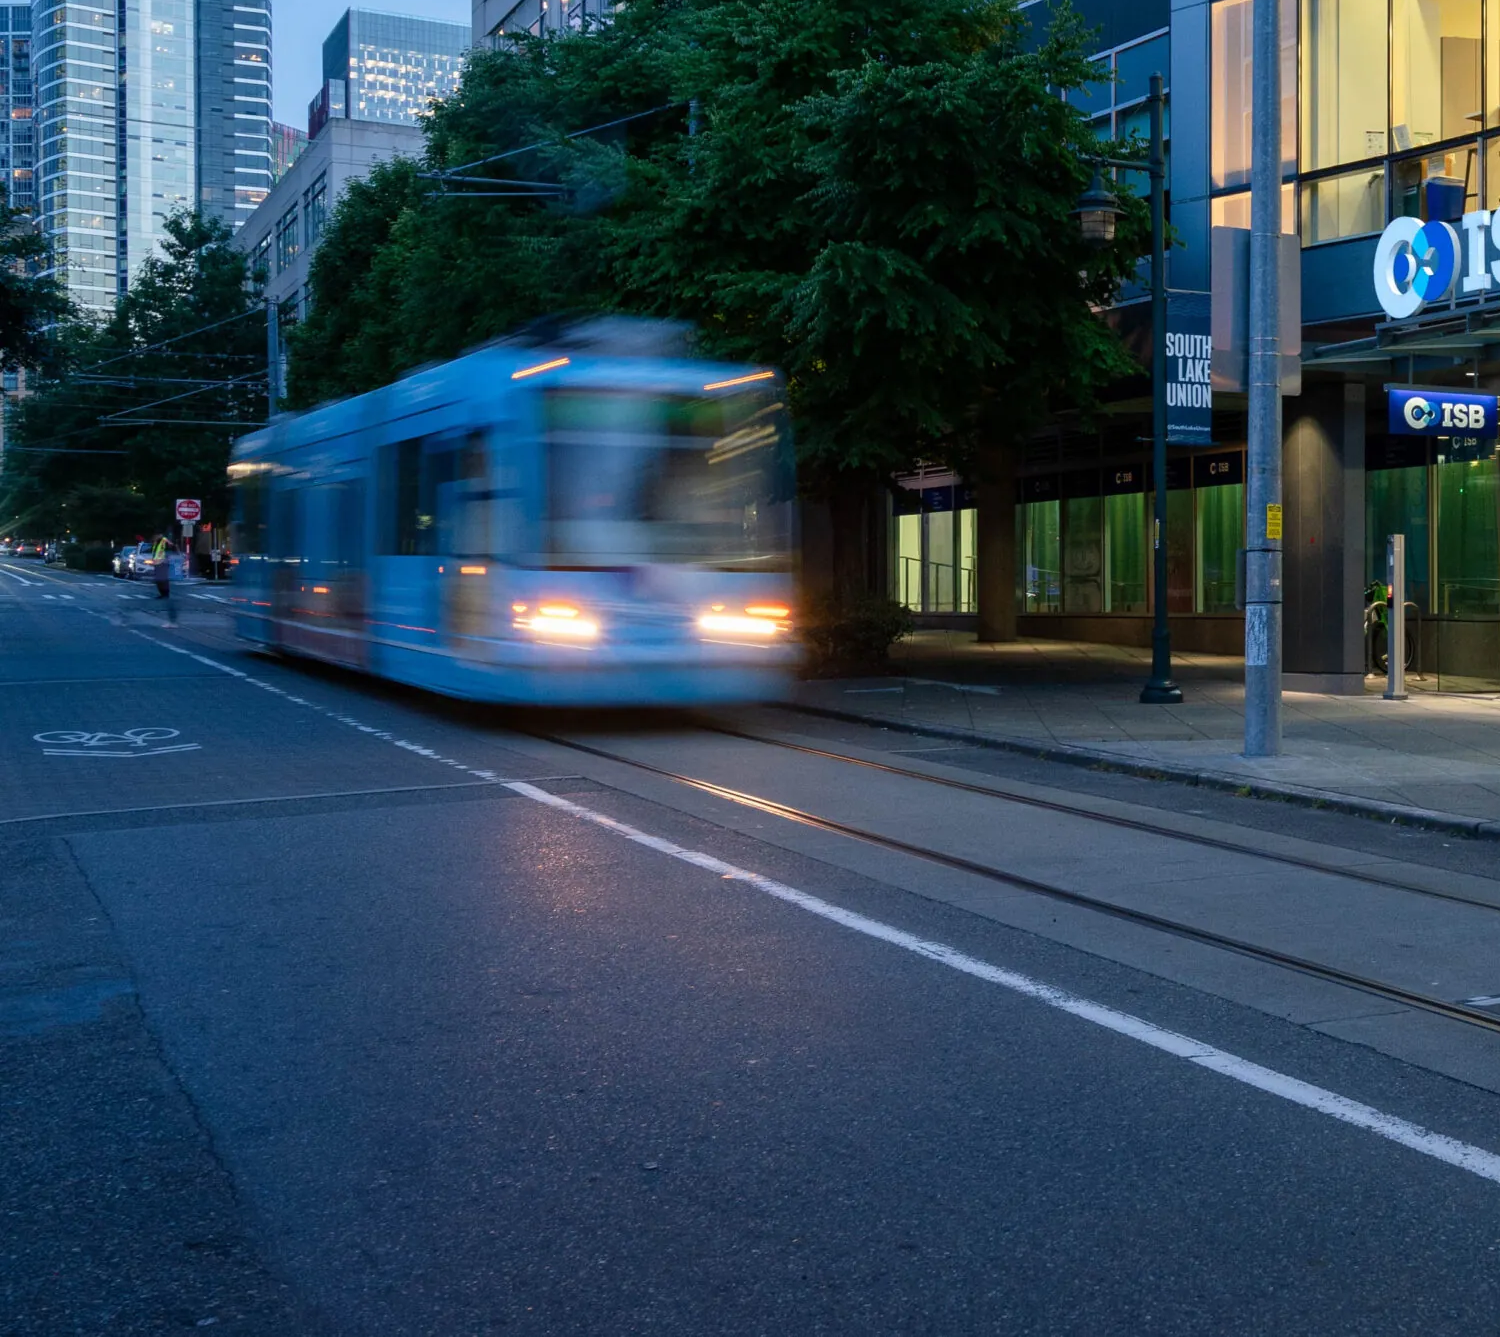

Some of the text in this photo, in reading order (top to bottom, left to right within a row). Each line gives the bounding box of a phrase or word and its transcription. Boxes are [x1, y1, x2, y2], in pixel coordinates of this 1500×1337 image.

[1166, 332, 1212, 359] SOUTH
[1178, 358, 1212, 383] LAKE
[1166, 382, 1212, 408] UNION
[1442, 402, 1486, 429] ISB
